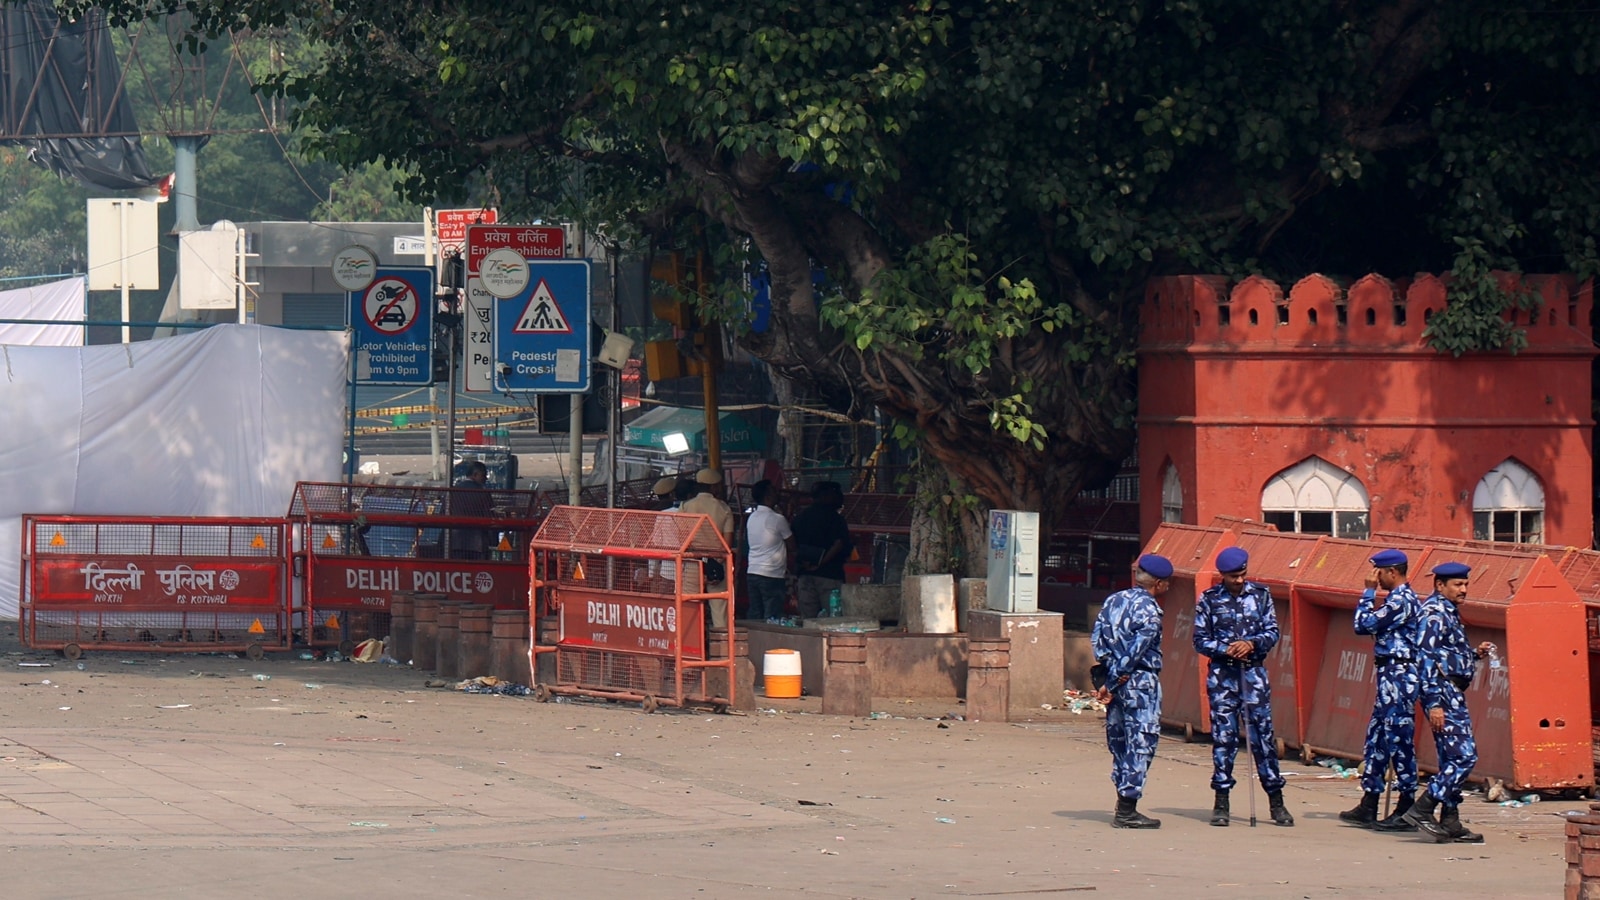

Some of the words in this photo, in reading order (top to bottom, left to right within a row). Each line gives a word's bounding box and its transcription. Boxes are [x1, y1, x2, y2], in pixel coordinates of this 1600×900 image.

[451, 230, 463, 238] AM
[484, 228, 511, 243] प्रवेश
[516, 228, 548, 244] वर्जित
[357, 342, 383, 351] otor
[385, 342, 427, 351] Vehicles
[512, 350, 556, 361] Pedestr
[385, 365, 395, 375] to
[397, 365, 419, 376] 9pm
[516, 363, 557, 374] Crossi
[80, 562, 145, 596] दिल्ली
[155, 564, 217, 596] पुलिस
[346, 566, 400, 591] DELHI
[412, 570, 473, 594] POLICE
[94, 593, 123, 603] NORTH
[190, 594, 228, 604] KOTWALI
[587, 600, 621, 627] DELHI
[626, 604, 665, 632] POLICE
[1337, 650, 1368, 682] DELHI
